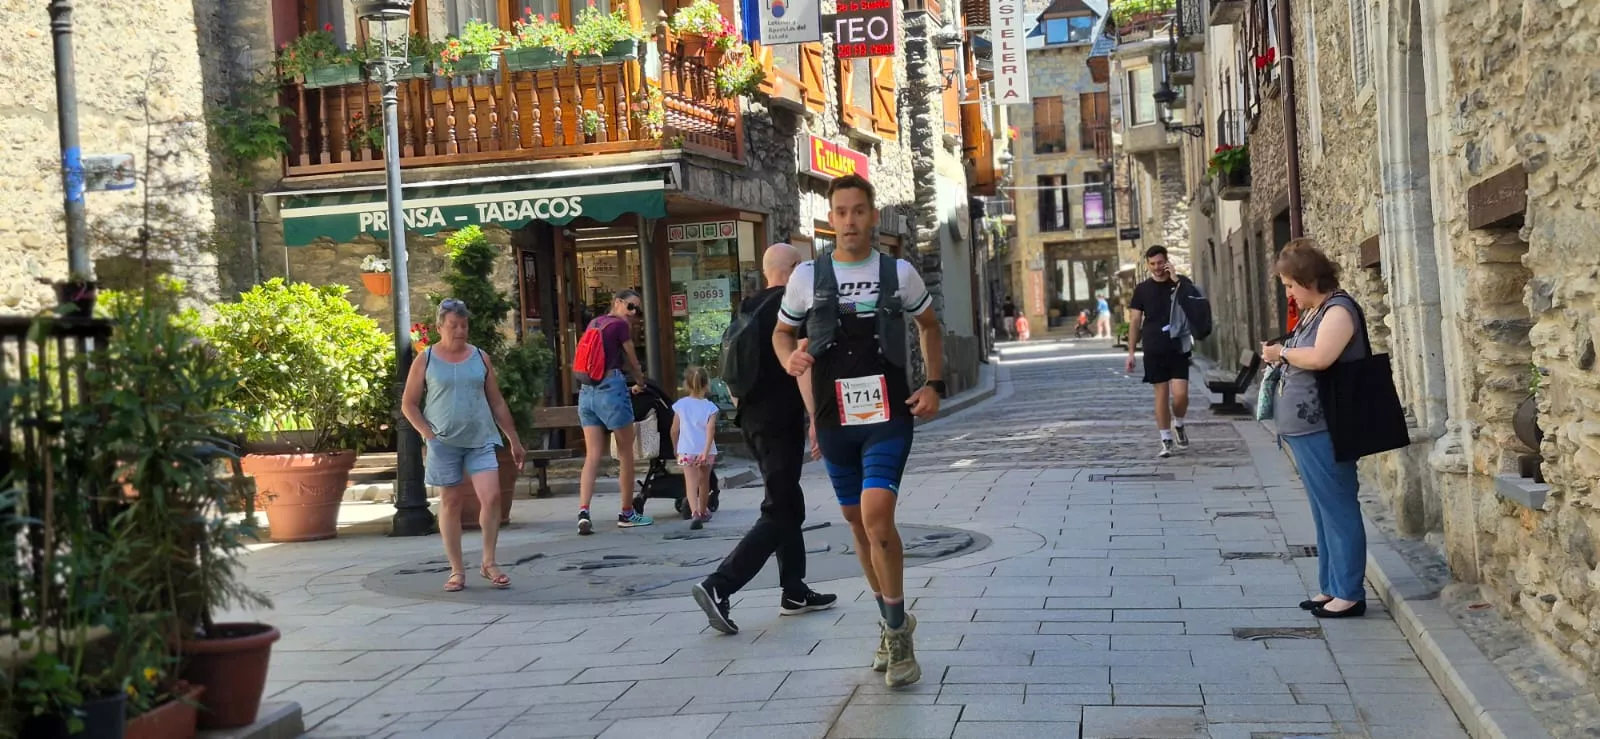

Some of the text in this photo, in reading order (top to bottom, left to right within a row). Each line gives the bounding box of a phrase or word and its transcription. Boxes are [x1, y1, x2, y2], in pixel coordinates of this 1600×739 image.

[999, 0, 1019, 98] STELERIA
[360, 206, 447, 232] PRNSA
[474, 196, 583, 223] TABACOS
[693, 289, 725, 300] 90693
[844, 388, 881, 404] 1714
